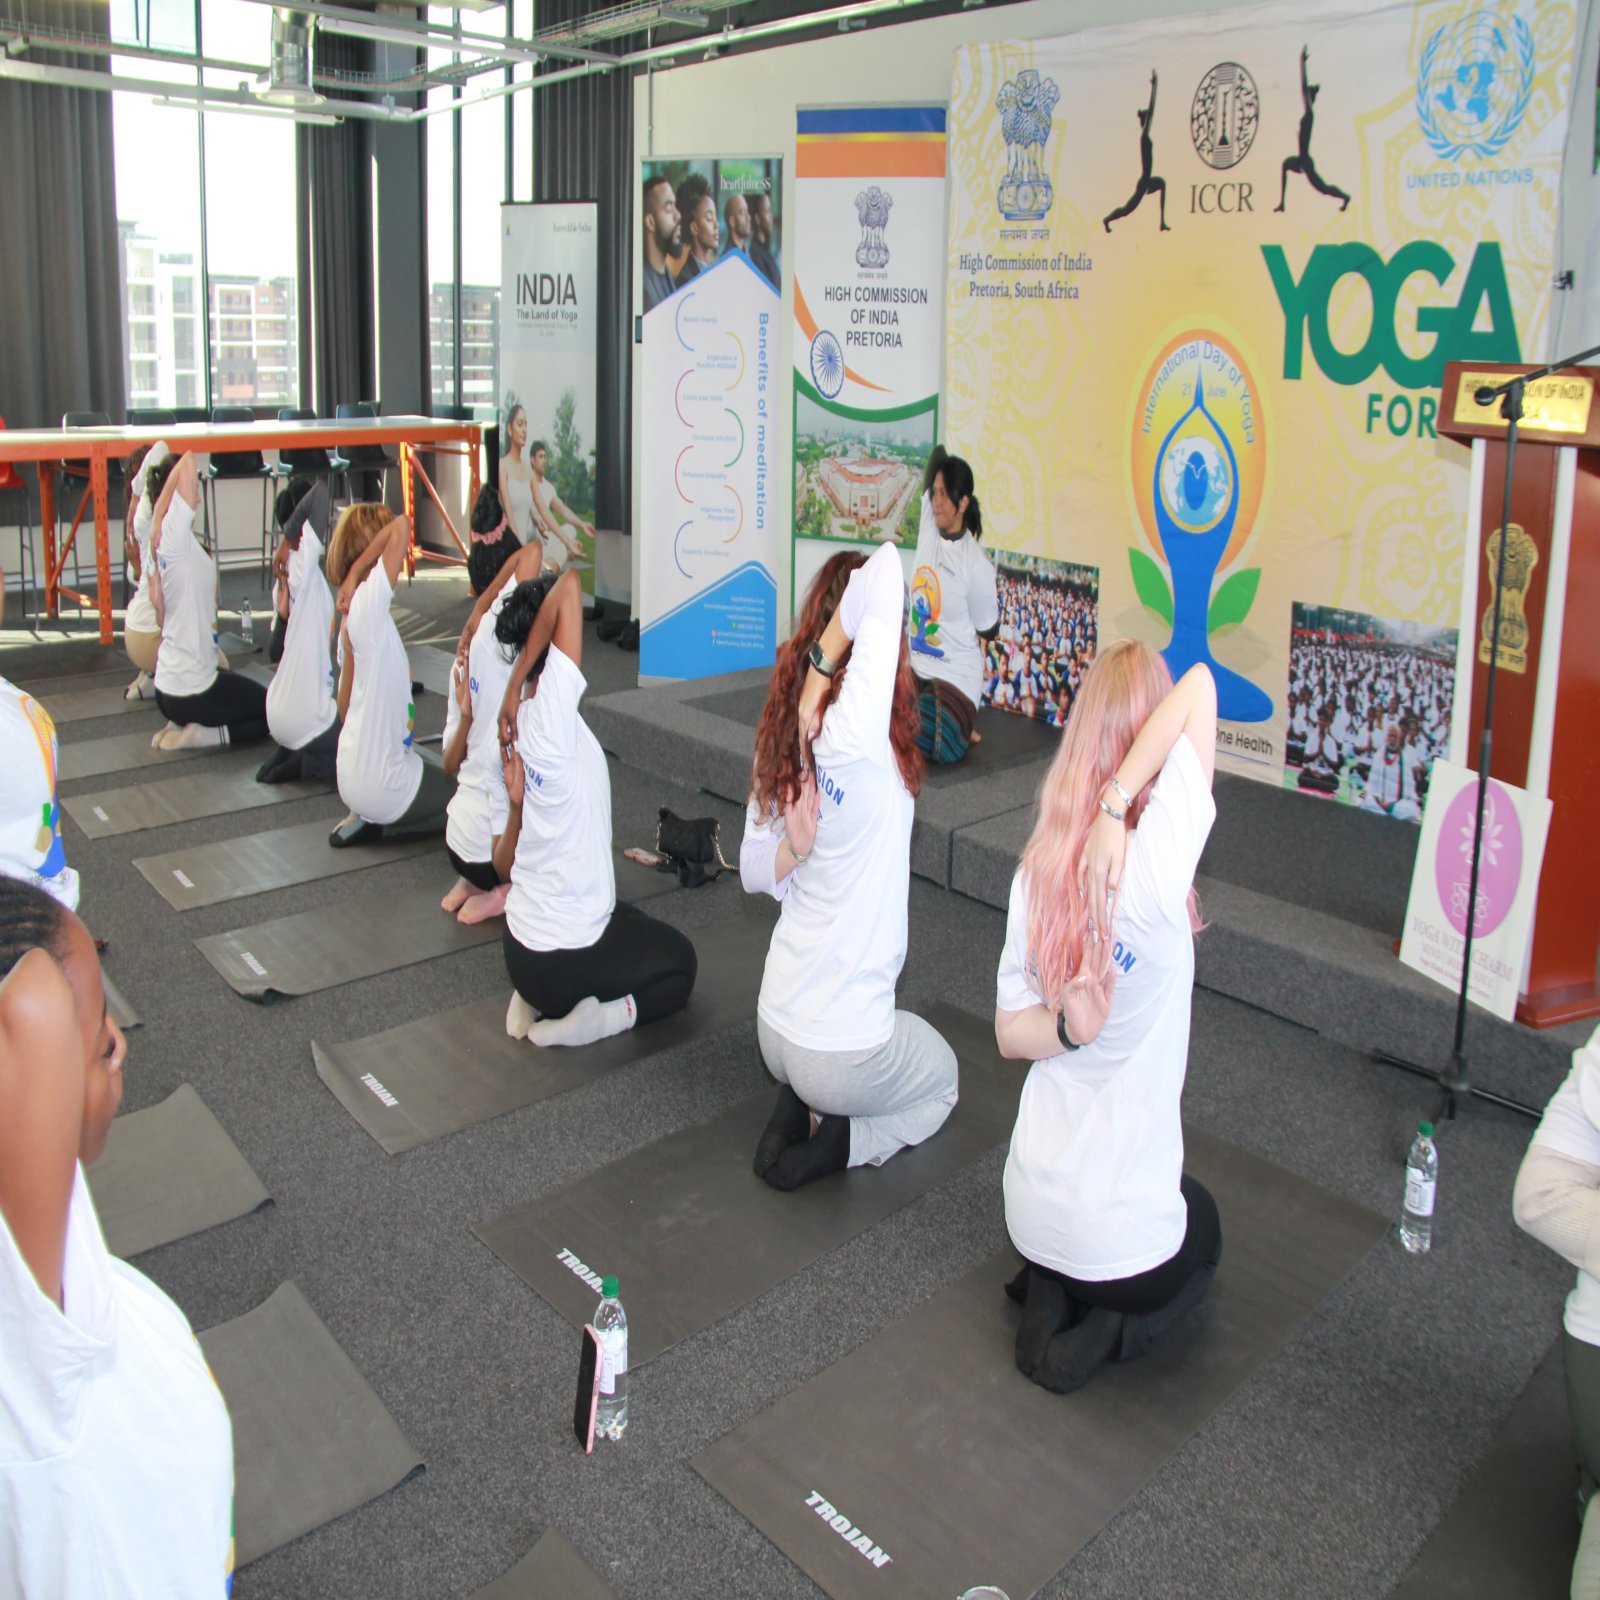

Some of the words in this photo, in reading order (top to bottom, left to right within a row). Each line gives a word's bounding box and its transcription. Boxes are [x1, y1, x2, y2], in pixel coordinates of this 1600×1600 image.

[1406, 172, 1461, 190] UNITED
[1465, 167, 1534, 187] NATIONS
[1190, 182, 1254, 214] ICCR
[959, 254, 983, 275] High
[985, 254, 1048, 271] Commission
[1050, 253, 1063, 270] of
[1063, 253, 1093, 271] India
[516, 273, 578, 305] INDIA
[825, 286, 851, 302] HIGH
[854, 287, 928, 304] COMMISSION
[969, 281, 1013, 300] Pretoria,
[1014, 281, 1045, 299] South
[1046, 281, 1080, 300] Africa
[516, 309, 530, 320] The
[532, 309, 550, 320] Land
[551, 309, 559, 320] of
[560, 309, 578, 322] Yoga
[851, 308, 866, 324] OF
[869, 309, 899, 325] INDIA
[1260, 239, 1522, 390] YOGA
[758, 313, 769, 392] Benefits
[846, 330, 903, 348] PRETORIA
[1141, 340, 1200, 434] International
[1203, 341, 1229, 371] Day
[1228, 366, 1245, 387] of
[1240, 384, 1255, 444] Yoga
[757, 398, 768, 419] of
[1366, 393, 1439, 439] FOR
[756, 425, 767, 529] meditation
[1236, 731, 1273, 756] Health
[360, 1072, 399, 1107] TROJAN
[556, 1247, 603, 1293] TROJA
[804, 1489, 893, 1568] TROJAN
